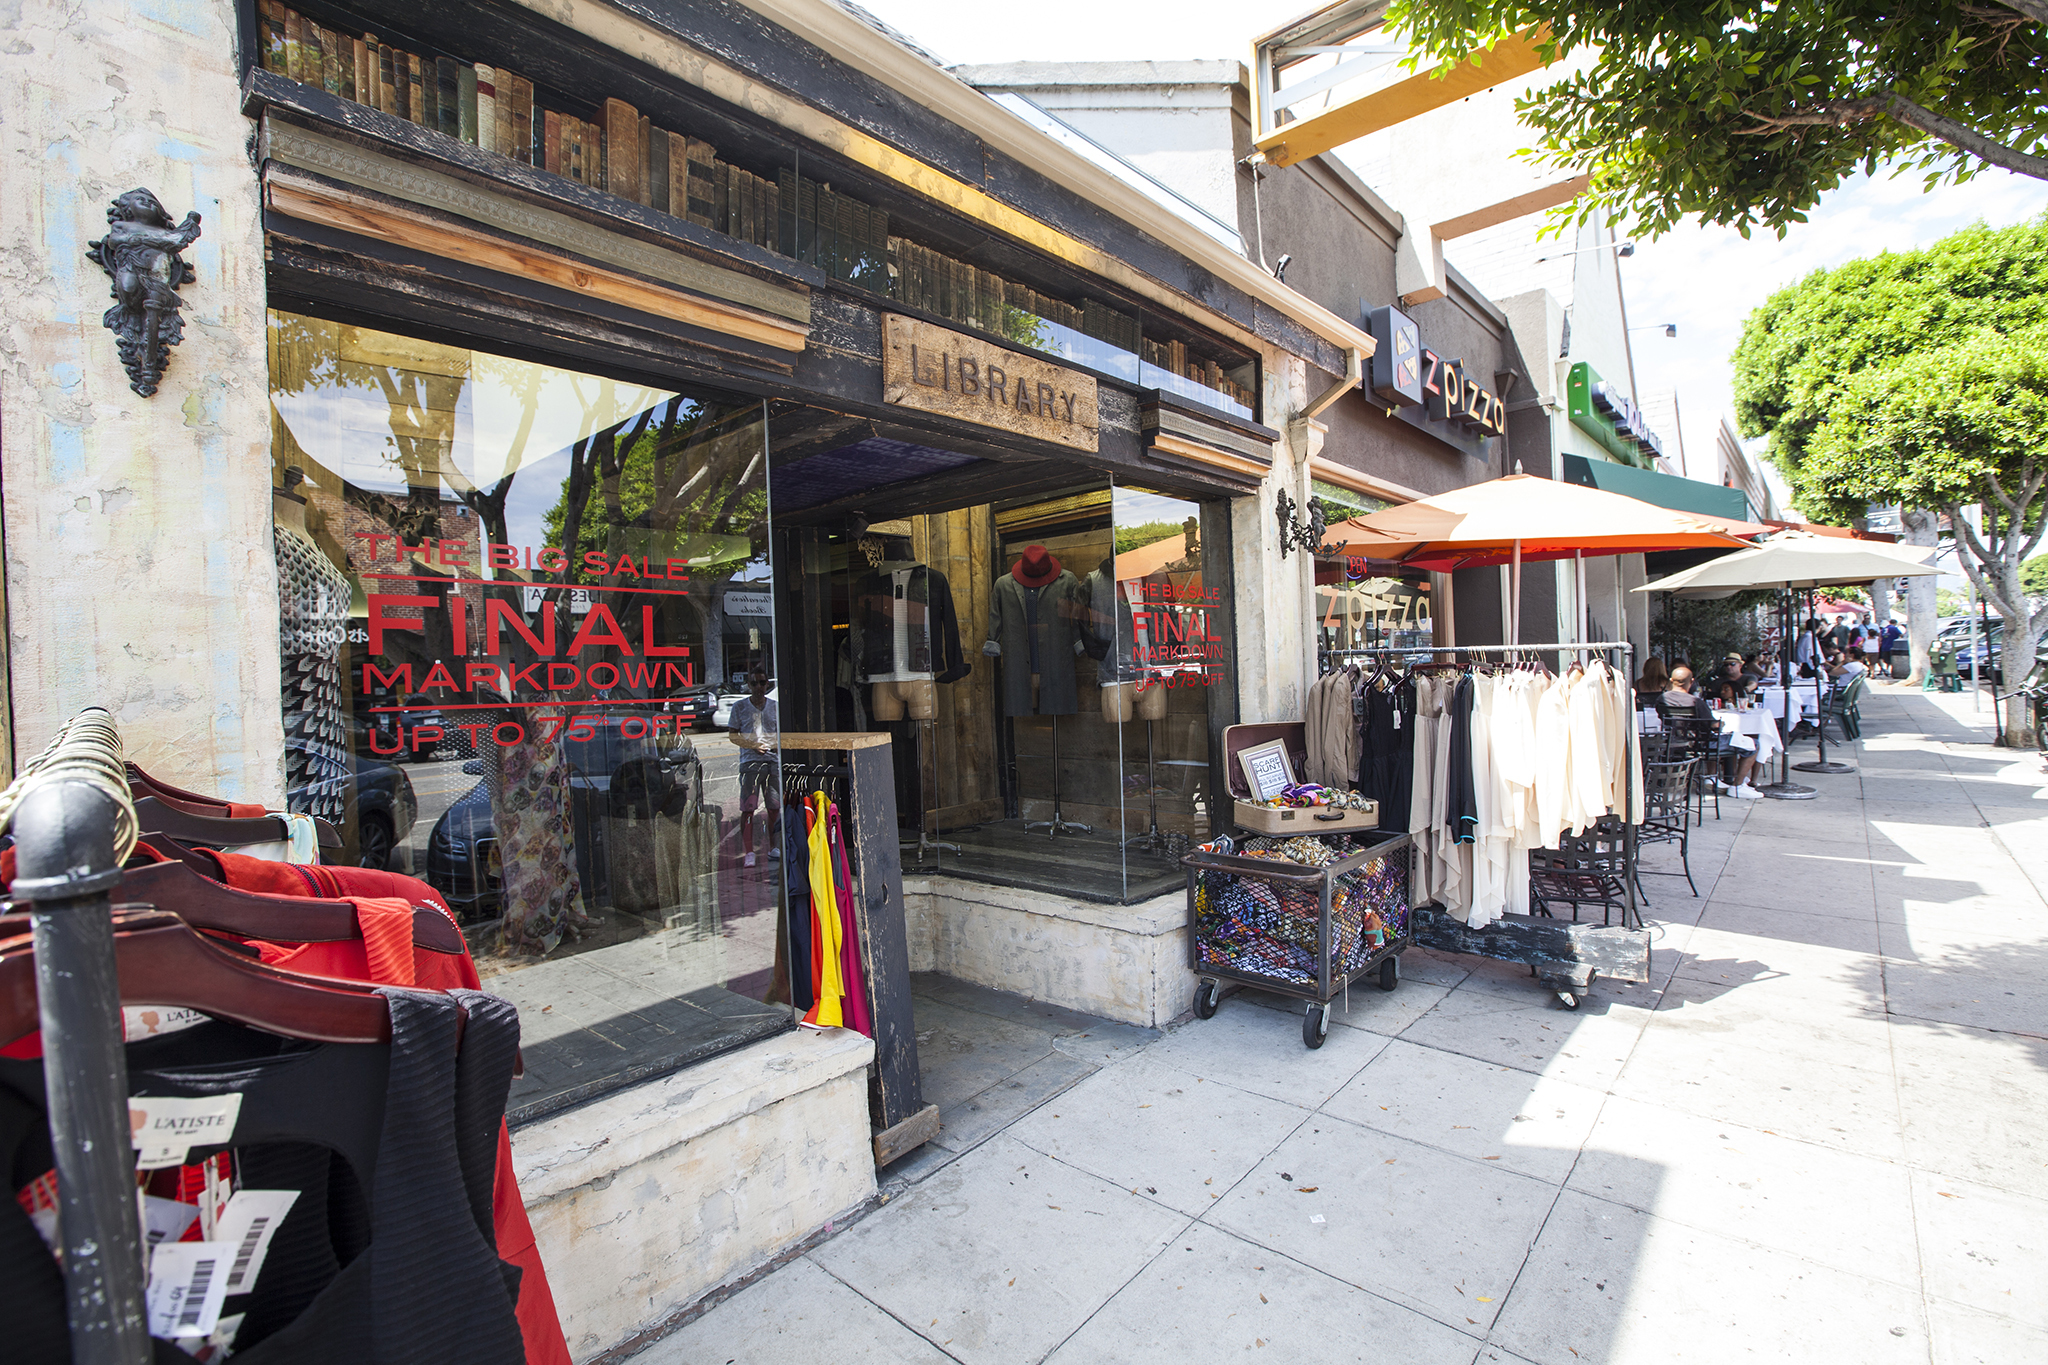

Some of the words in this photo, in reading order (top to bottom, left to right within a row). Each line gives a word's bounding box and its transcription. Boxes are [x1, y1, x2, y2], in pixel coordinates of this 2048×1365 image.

[911, 343, 1077, 424] LIBRARY
[355, 532, 469, 566] THE
[488, 543, 569, 573] BIG
[584, 551, 689, 580] SALE
[1129, 582, 1158, 597] THE
[1162, 584, 1185, 598] BIG
[1189, 586, 1220, 600] SALE
[368, 594, 690, 656] FINAL
[1133, 612, 1221, 643] FINAL
[1133, 645, 1223, 662] MARKDOWN
[363, 662, 693, 694] MARKDOWN
[1135, 677, 1155, 692] UP
[1158, 676, 1176, 689] TO
[1202, 673, 1224, 686] OFF
[369, 726, 444, 754] UP
[459, 722, 525, 748] TO
[538, 713, 609, 744] 75%
[620, 714, 697, 740] OFF
[1253, 757, 1280, 768] SCARF
[1256, 761, 1282, 774] HUNT
[154, 1115, 226, 1130] L'ATISTE
